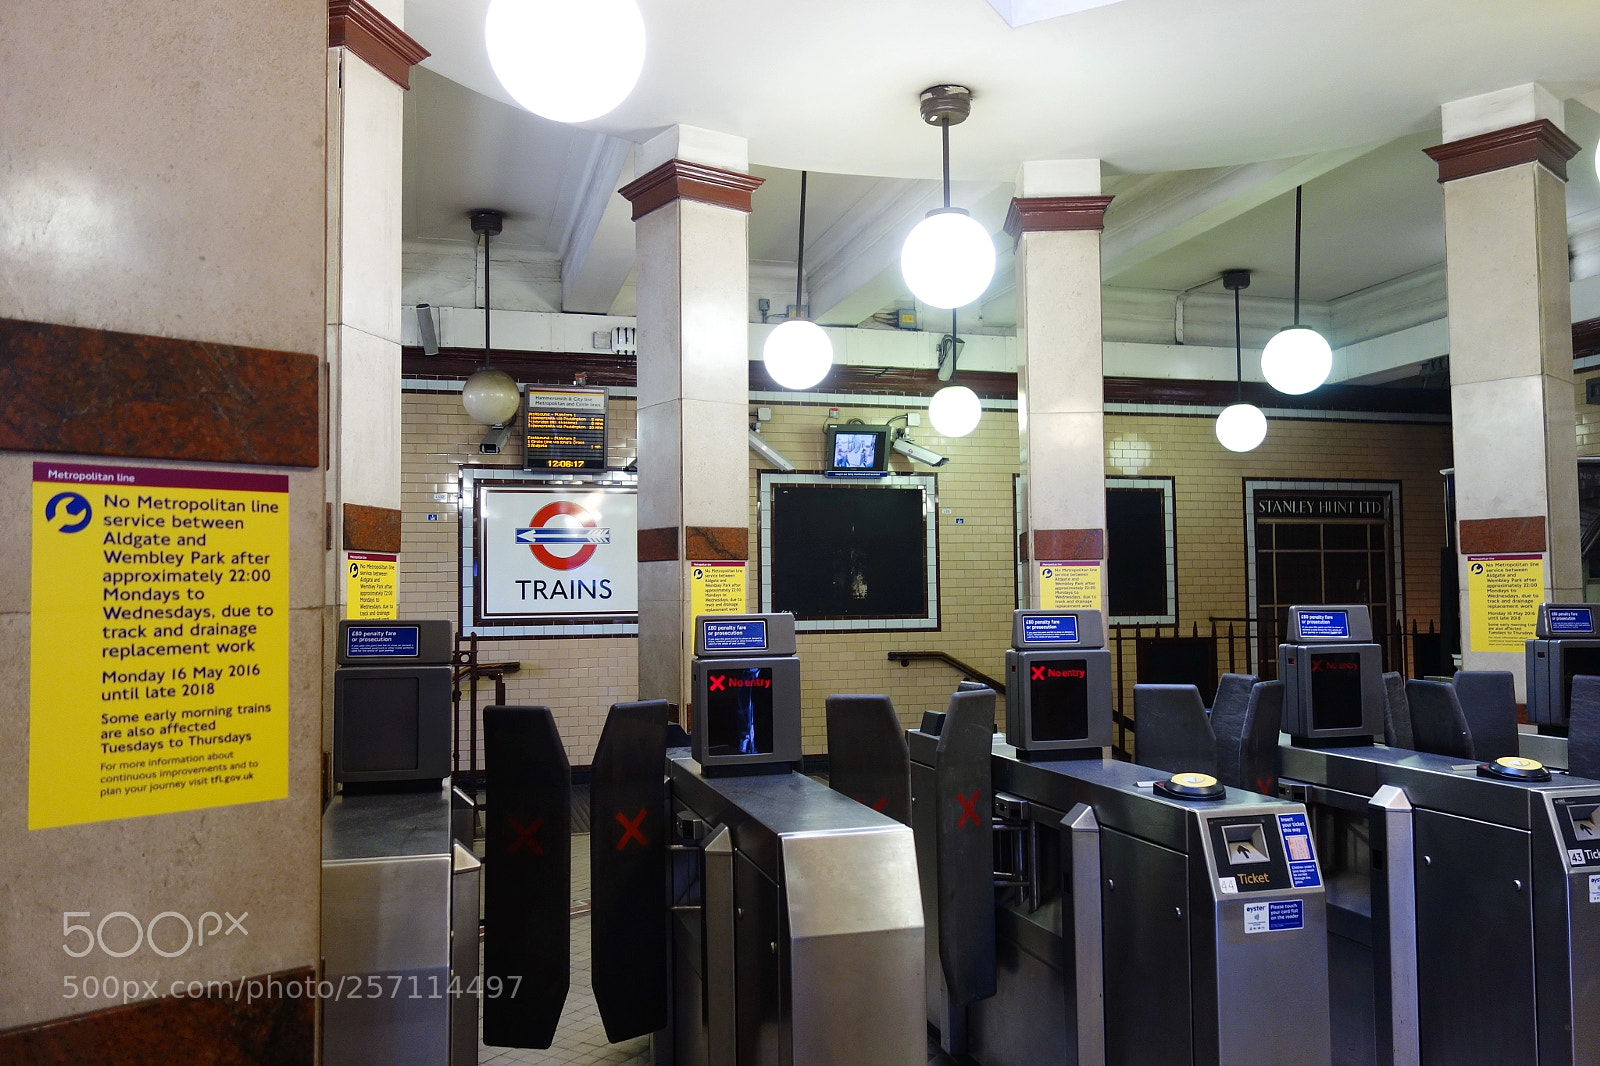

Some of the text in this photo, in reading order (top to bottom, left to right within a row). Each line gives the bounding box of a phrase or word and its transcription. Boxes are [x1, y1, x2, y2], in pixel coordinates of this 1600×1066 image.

[48, 470, 135, 482] Metropolitan line
[104, 494, 278, 514] No Metropolitan line
[1259, 500, 1381, 514] STANLEY HUNT LTD
[104, 515, 244, 529] service between
[104, 532, 206, 548] Aldgate and
[104, 550, 270, 567] Wembley Park after
[103, 569, 270, 585] approximately 22:00
[103, 588, 204, 602] Mondays to
[515, 579, 612, 600] TRAINS
[103, 605, 273, 621] Wednesdays, due to
[102, 623, 257, 639] track and drainage
[102, 640, 255, 660] replacement work
[102, 664, 260, 685] Monday 16 May 2016
[1048, 668, 1085, 678] No entry
[728, 678, 771, 688] No entry
[102, 684, 214, 701] until late 2018
[102, 703, 271, 724] Some early morning trains
[101, 720, 216, 740] are also affected
[102, 732, 251, 754] Tuesdays to Thursdays
[100, 750, 233, 771] For more information about
[100, 760, 258, 783] continuous improvements and to
[100, 772, 254, 798] plan your journey visit tfl.gov.uk
[1572, 853, 1583, 862] 43
[1222, 880, 1234, 889] 44
[1237, 872, 1270, 884] Ticket
